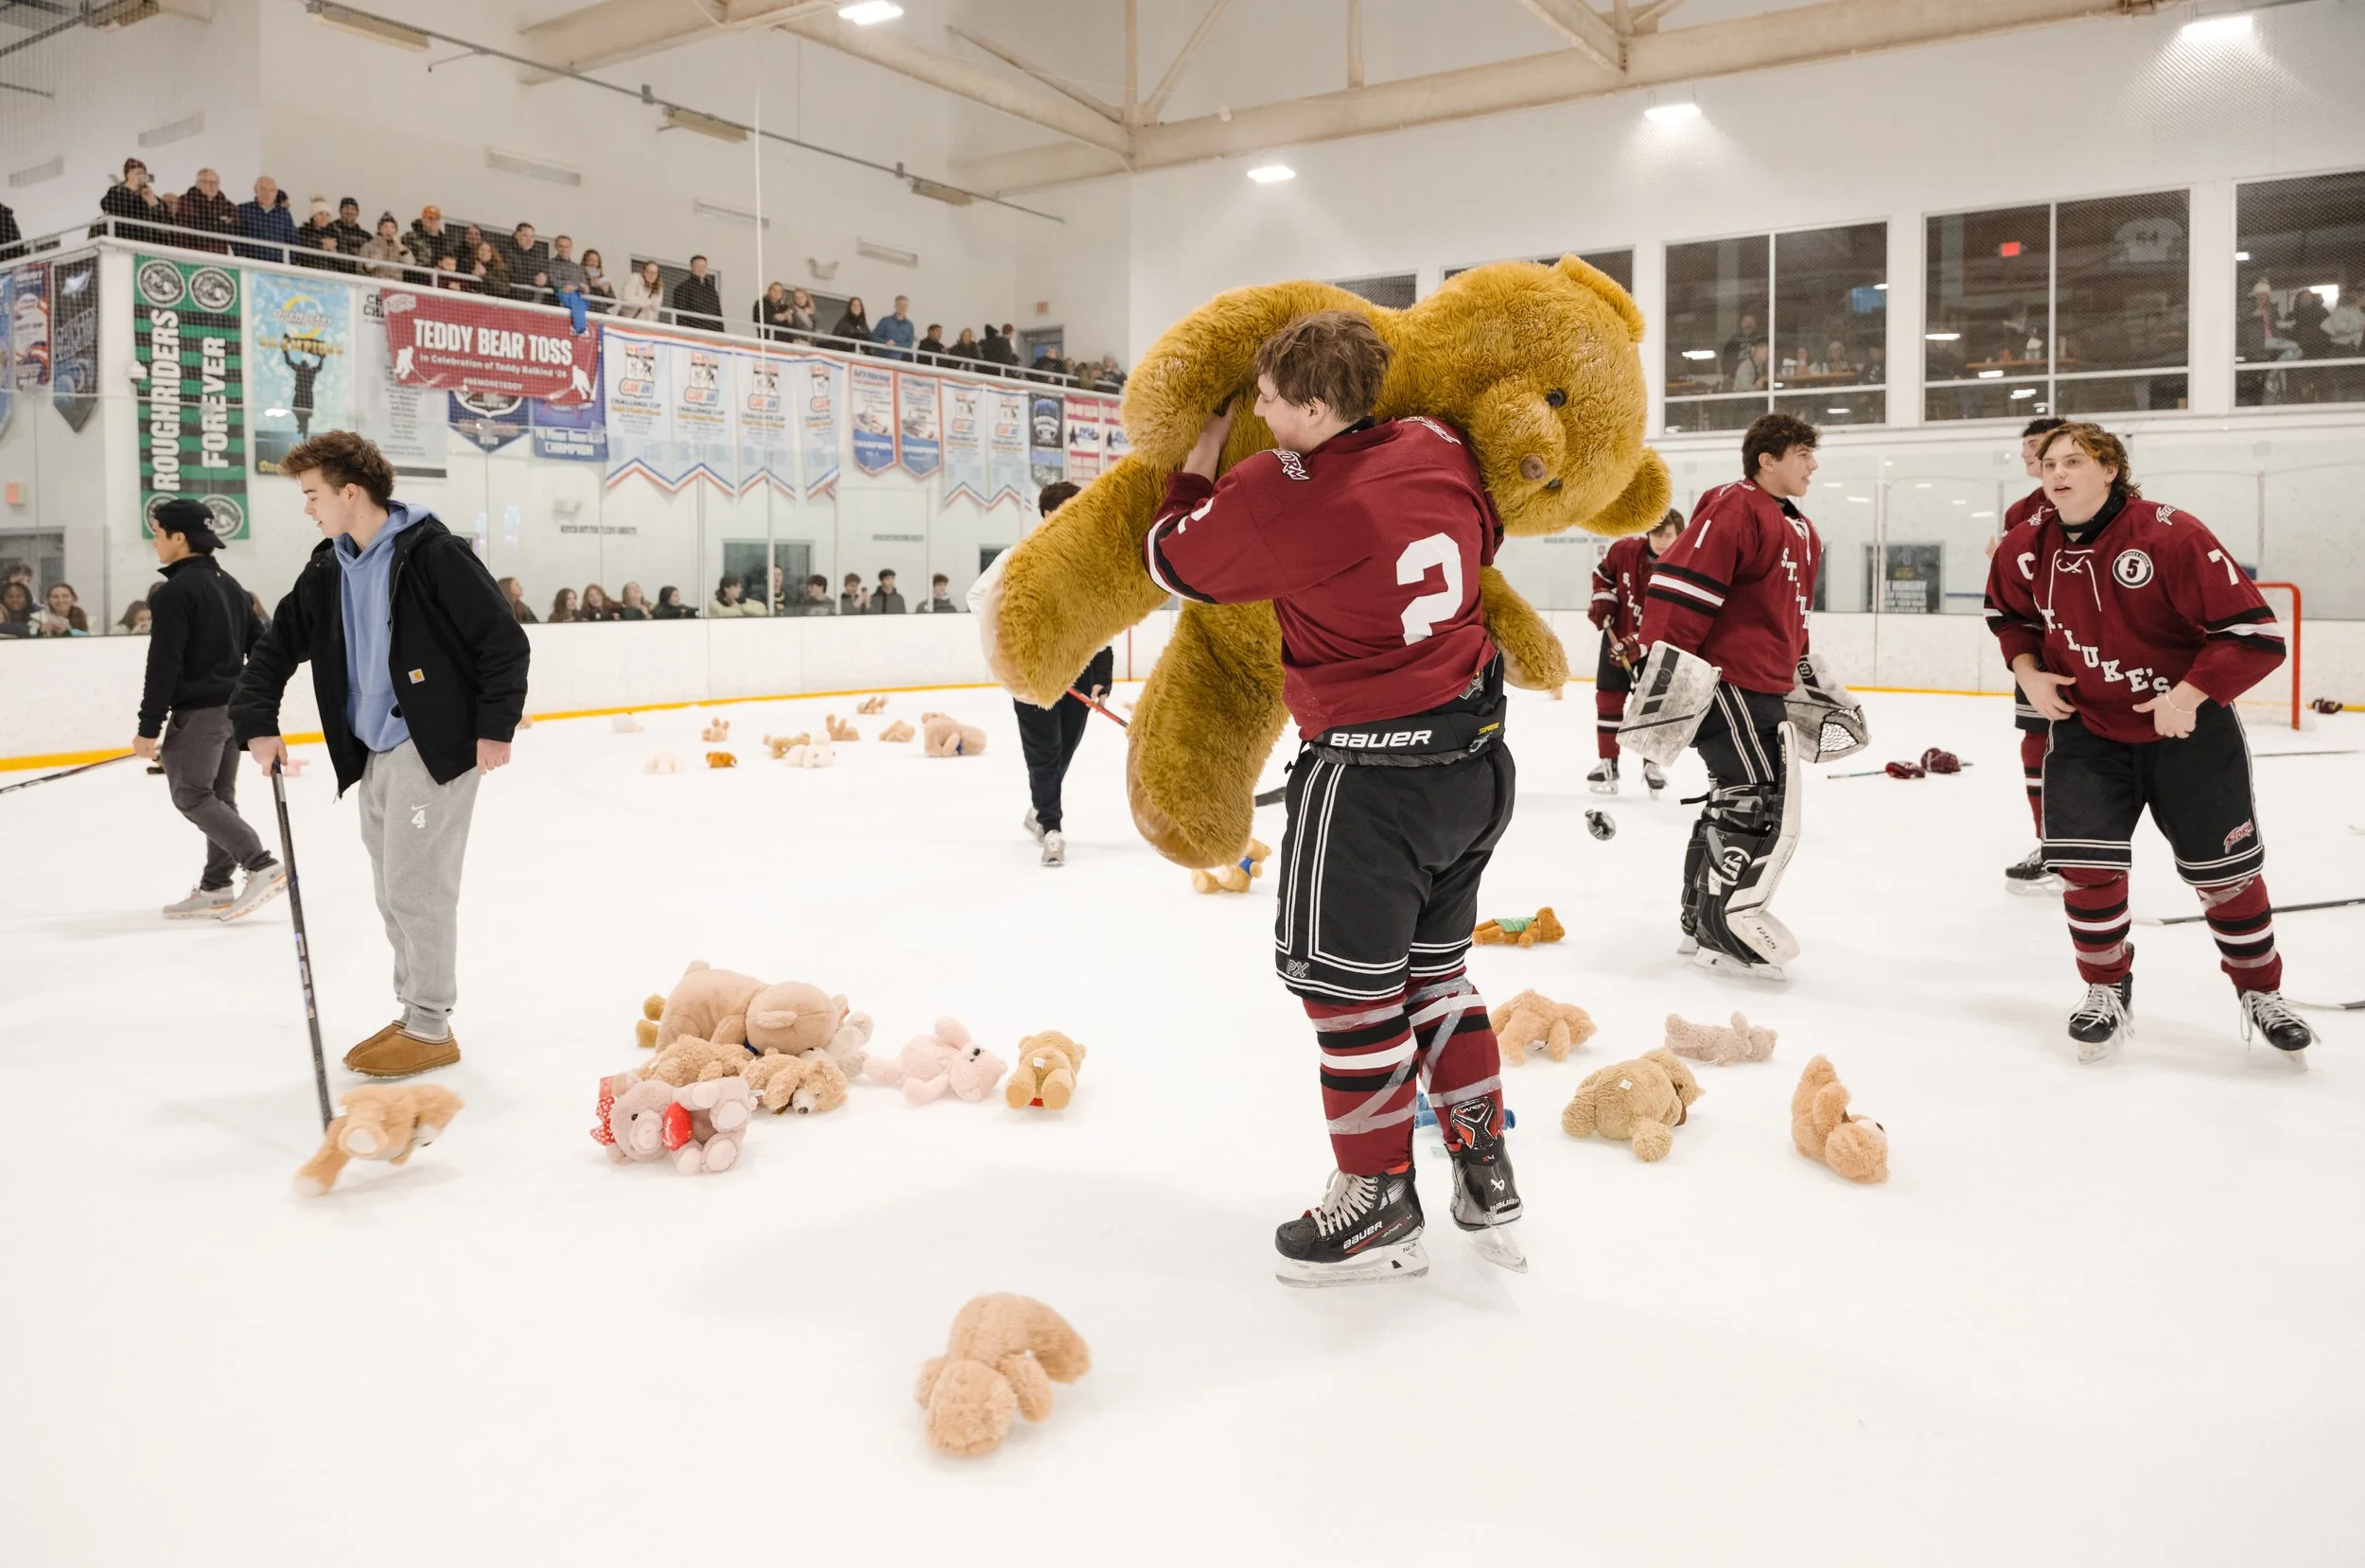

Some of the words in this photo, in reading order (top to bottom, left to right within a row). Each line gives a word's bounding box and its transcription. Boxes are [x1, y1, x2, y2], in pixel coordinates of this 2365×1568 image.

[413, 318, 473, 354] TEDDY
[477, 327, 525, 360] BEAR
[529, 334, 573, 366] TOSS
[420, 354, 429, 362] In
[430, 355, 483, 369] Celebration
[484, 359, 494, 370] of
[495, 361, 521, 375] Teddy
[150, 308, 181, 492] ROUGHRIDERS
[201, 336, 229, 469] FOREVER
[1694, 519, 1712, 549] 1
[2017, 551, 2036, 580] C
[2126, 558, 2140, 579] 5
[2207, 549, 2239, 585] 7
[1395, 532, 1463, 647] 2
[2063, 629, 2171, 697] LUKE'S
[1330, 729, 1432, 748] BAUER
[412, 809, 426, 828] 4
[2223, 818, 2255, 854] STORM
[1287, 959, 1310, 979] PX
[1489, 1197, 1520, 1213] BAUER
[1343, 1220, 1383, 1249] BAUER
